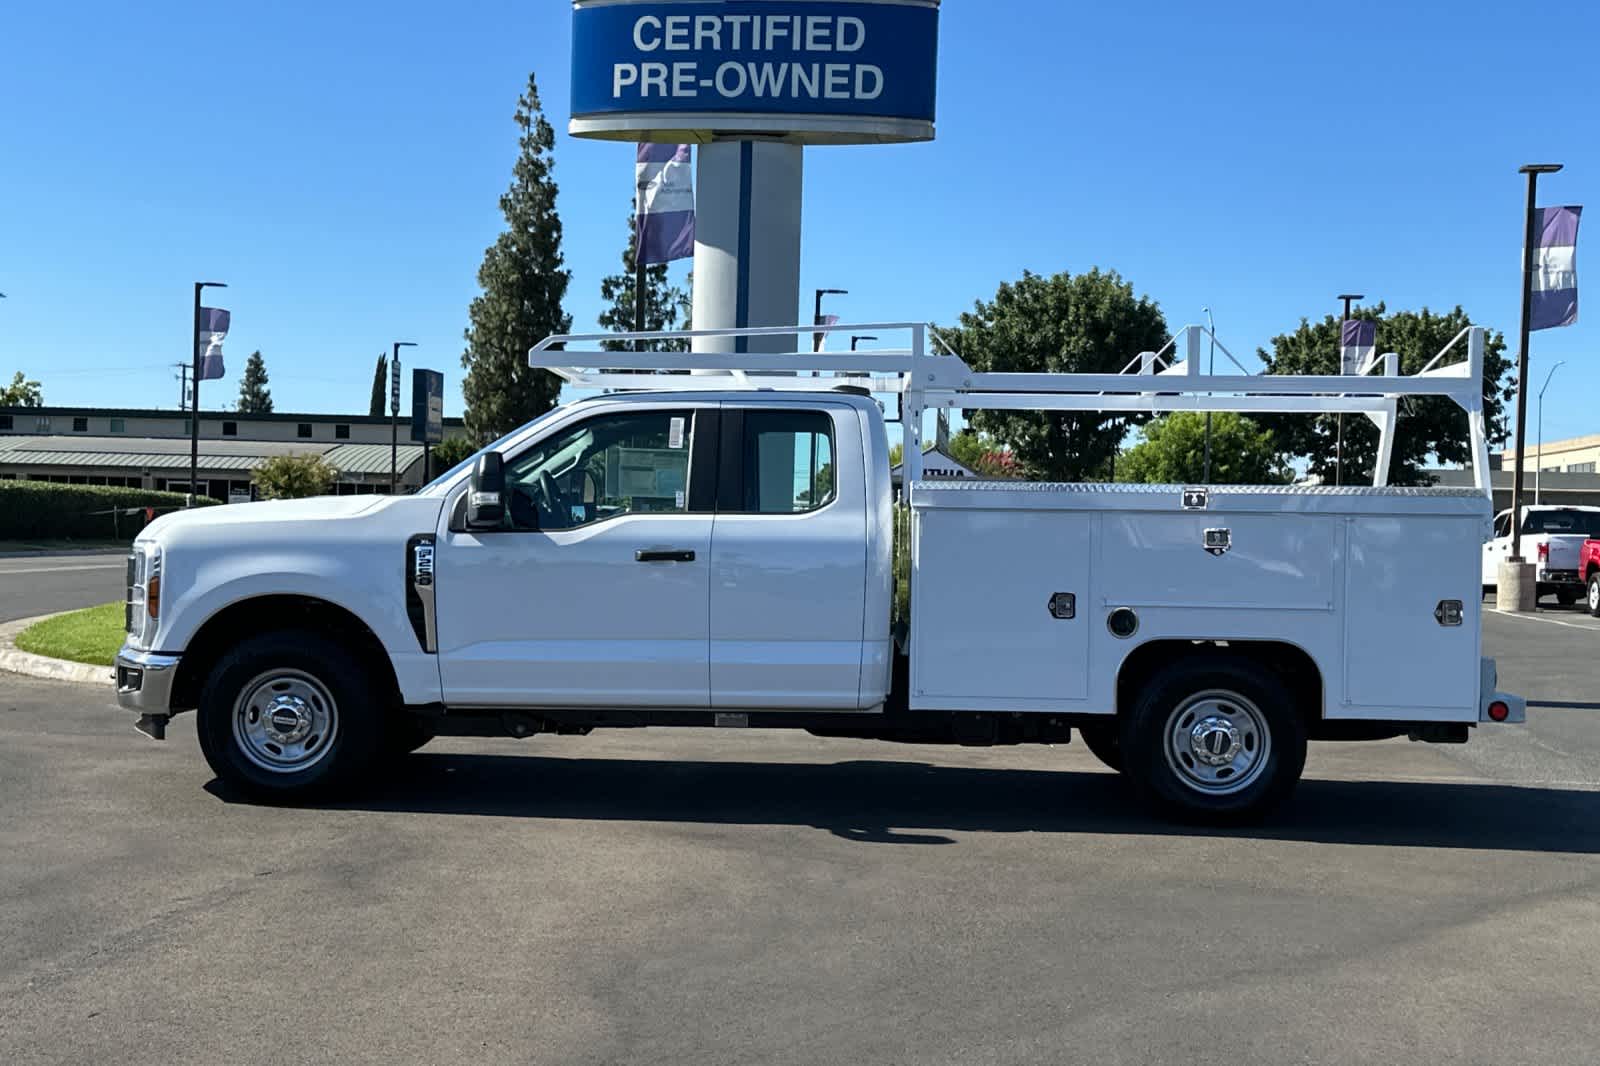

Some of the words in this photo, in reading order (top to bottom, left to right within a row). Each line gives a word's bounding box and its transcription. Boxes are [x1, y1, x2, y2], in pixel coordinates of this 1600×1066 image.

[633, 15, 866, 52] CERTIFIED
[612, 61, 884, 100] PRE-OWNED
[922, 468, 965, 477] ITHIA
